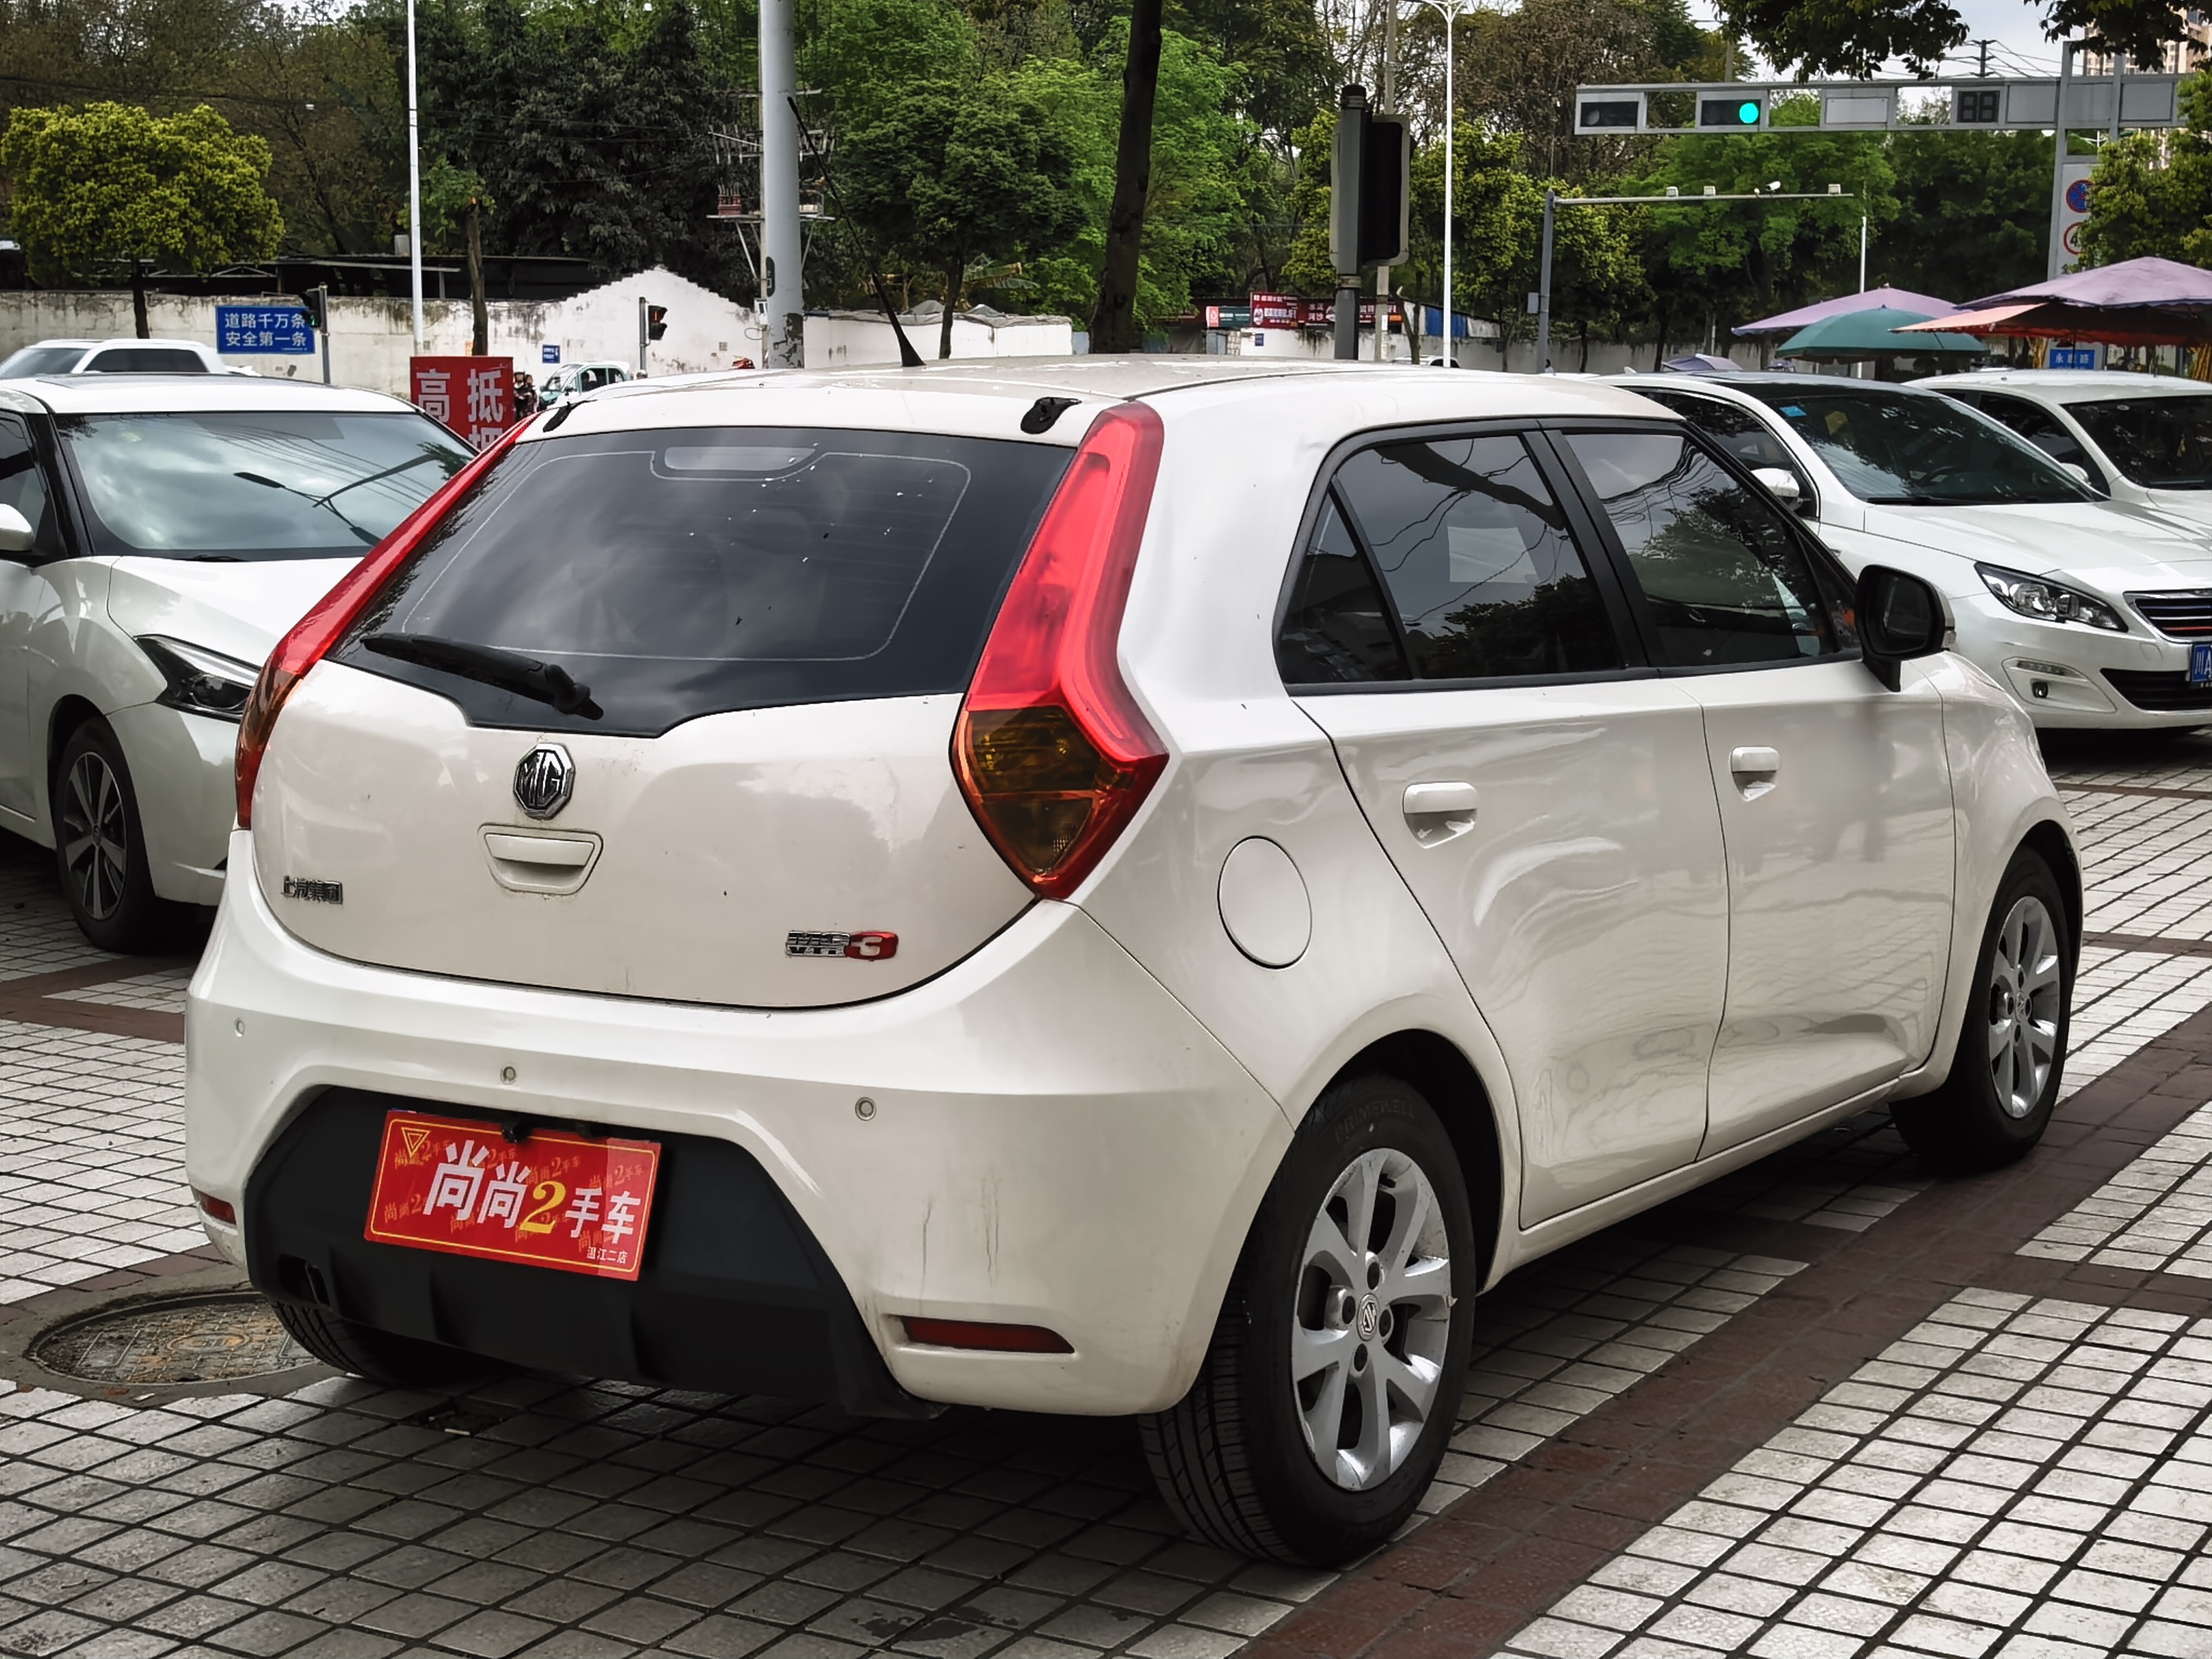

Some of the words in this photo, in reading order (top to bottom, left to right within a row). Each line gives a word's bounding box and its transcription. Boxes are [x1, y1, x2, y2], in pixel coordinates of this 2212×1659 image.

[225, 313, 305, 329] 道路千万条
[225, 331, 306, 347] 安全第一条
[423, 1139, 642, 1245] 尚尚2手车
